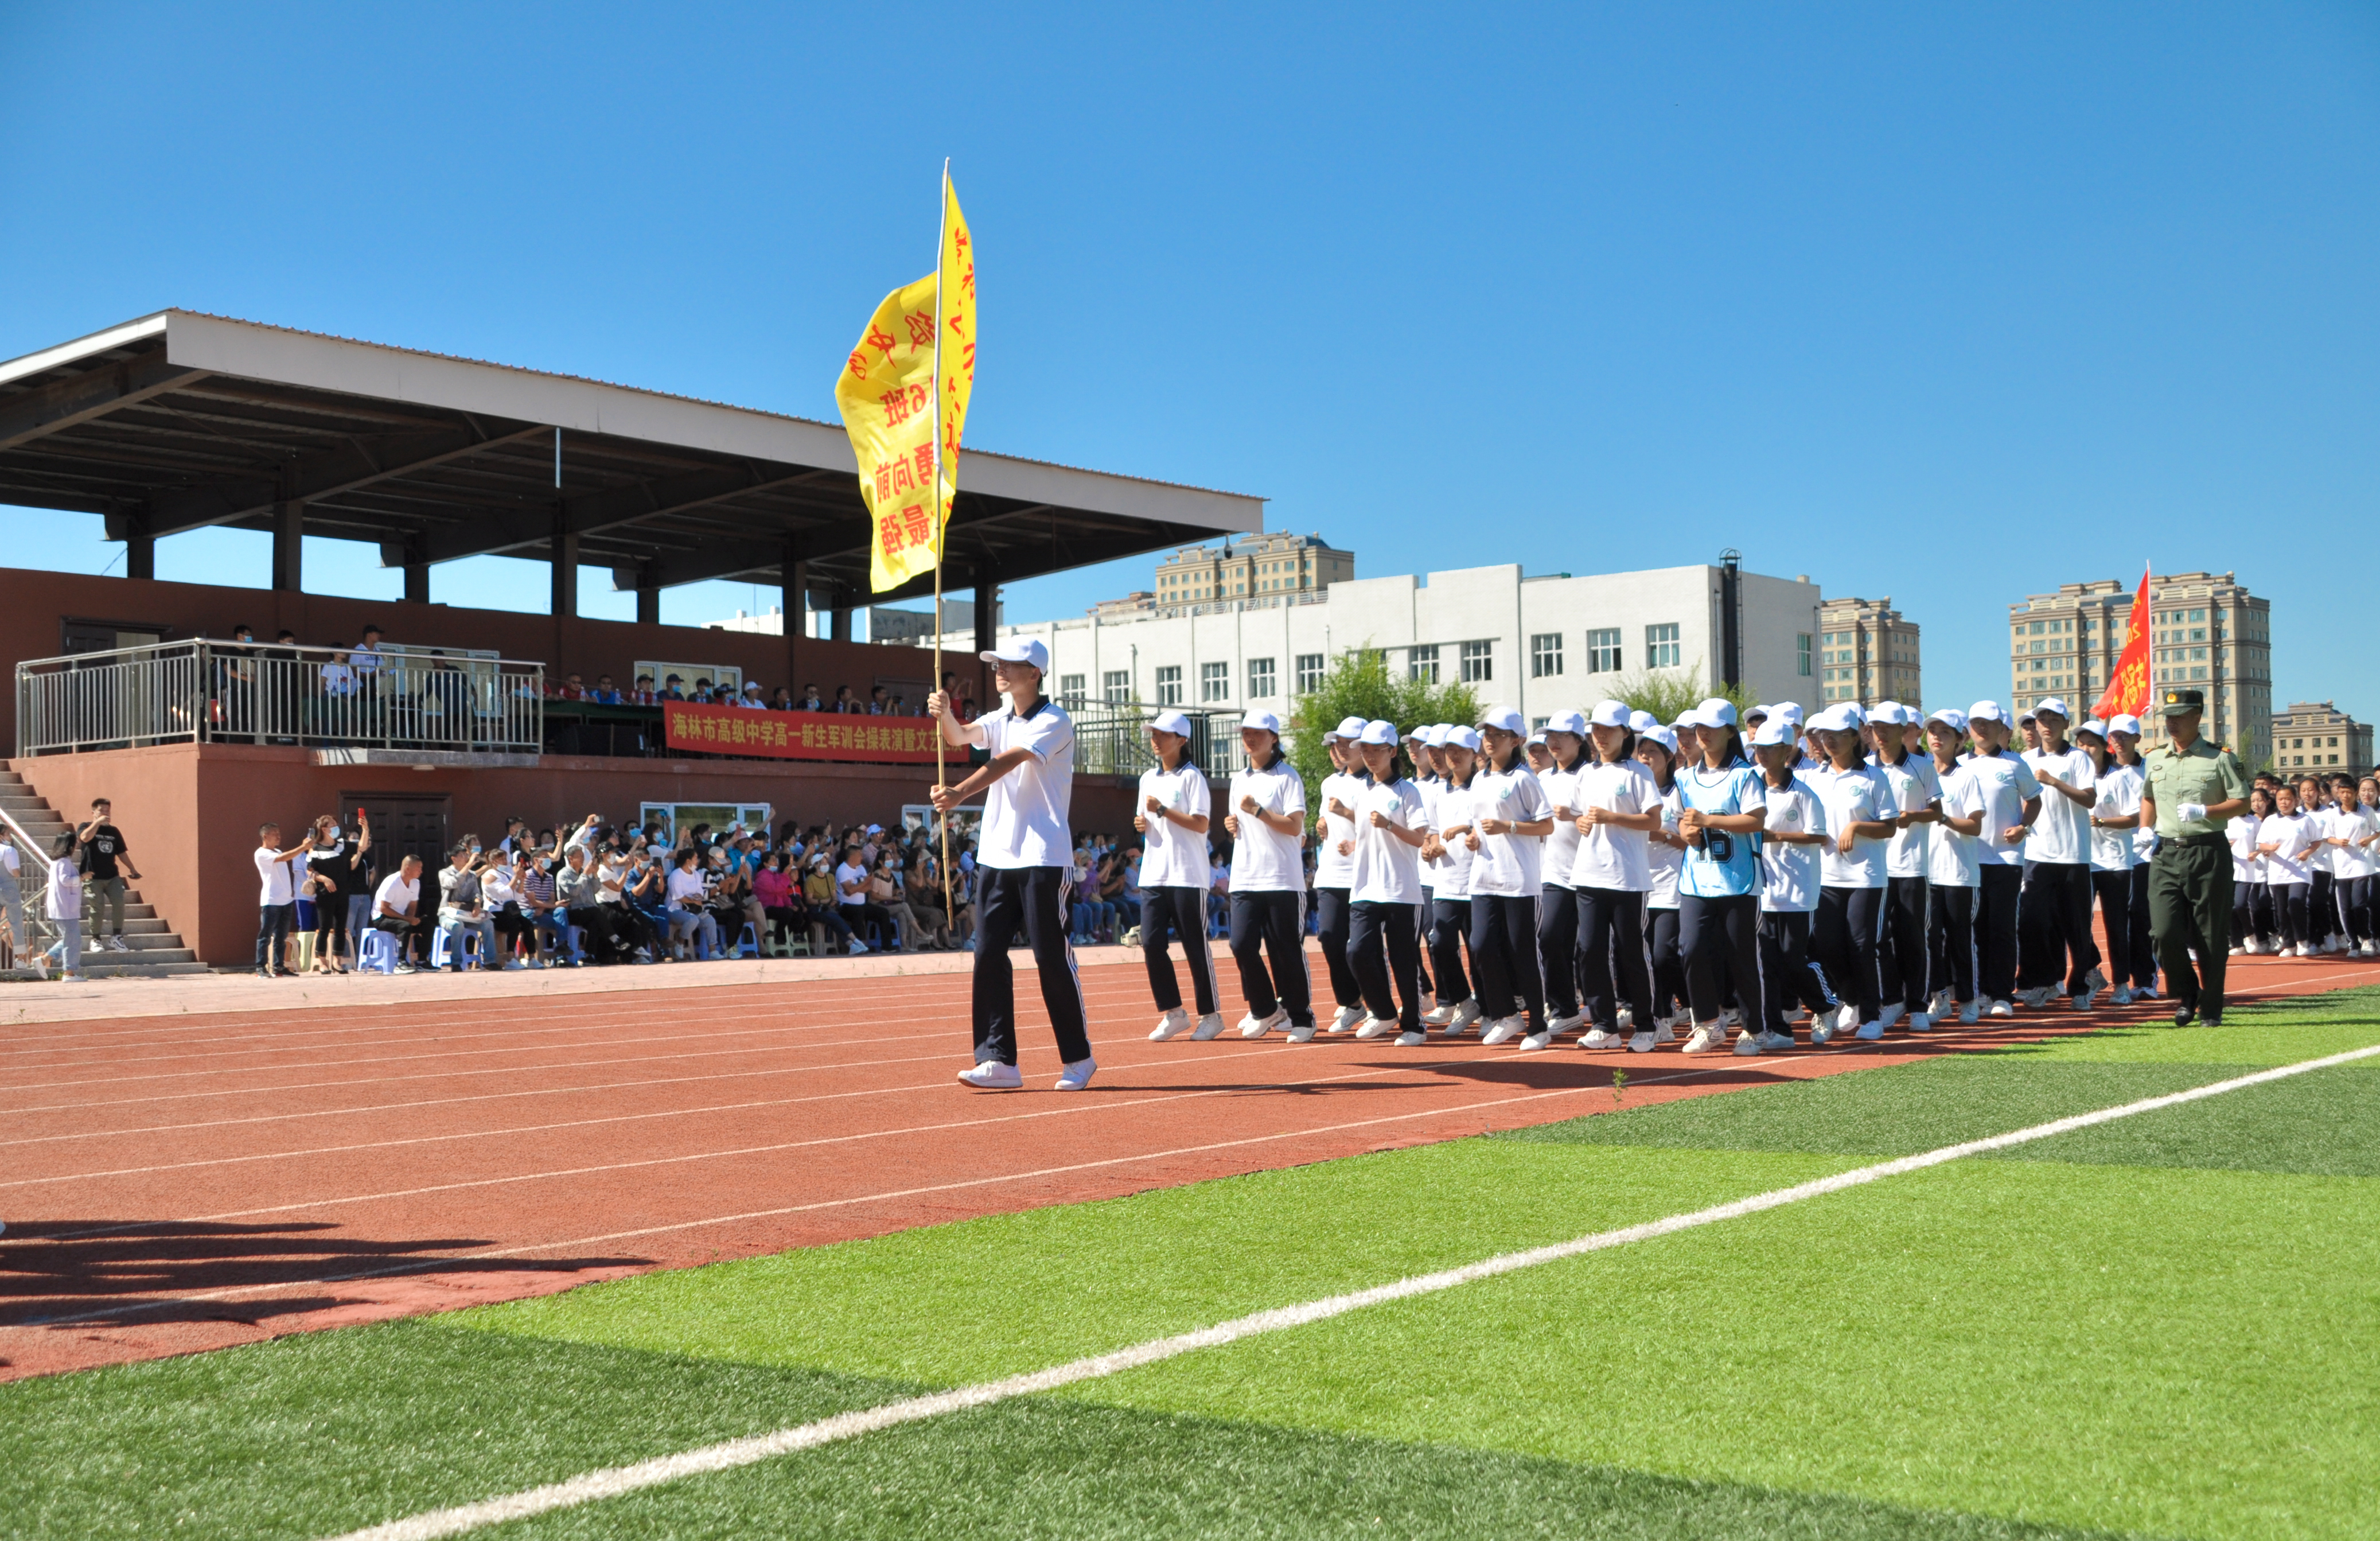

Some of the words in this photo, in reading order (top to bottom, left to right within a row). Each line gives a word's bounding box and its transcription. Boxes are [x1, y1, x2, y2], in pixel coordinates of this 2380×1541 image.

[672, 713, 962, 752] 海林市高级中学高一新生军训会操表演暨文艺
